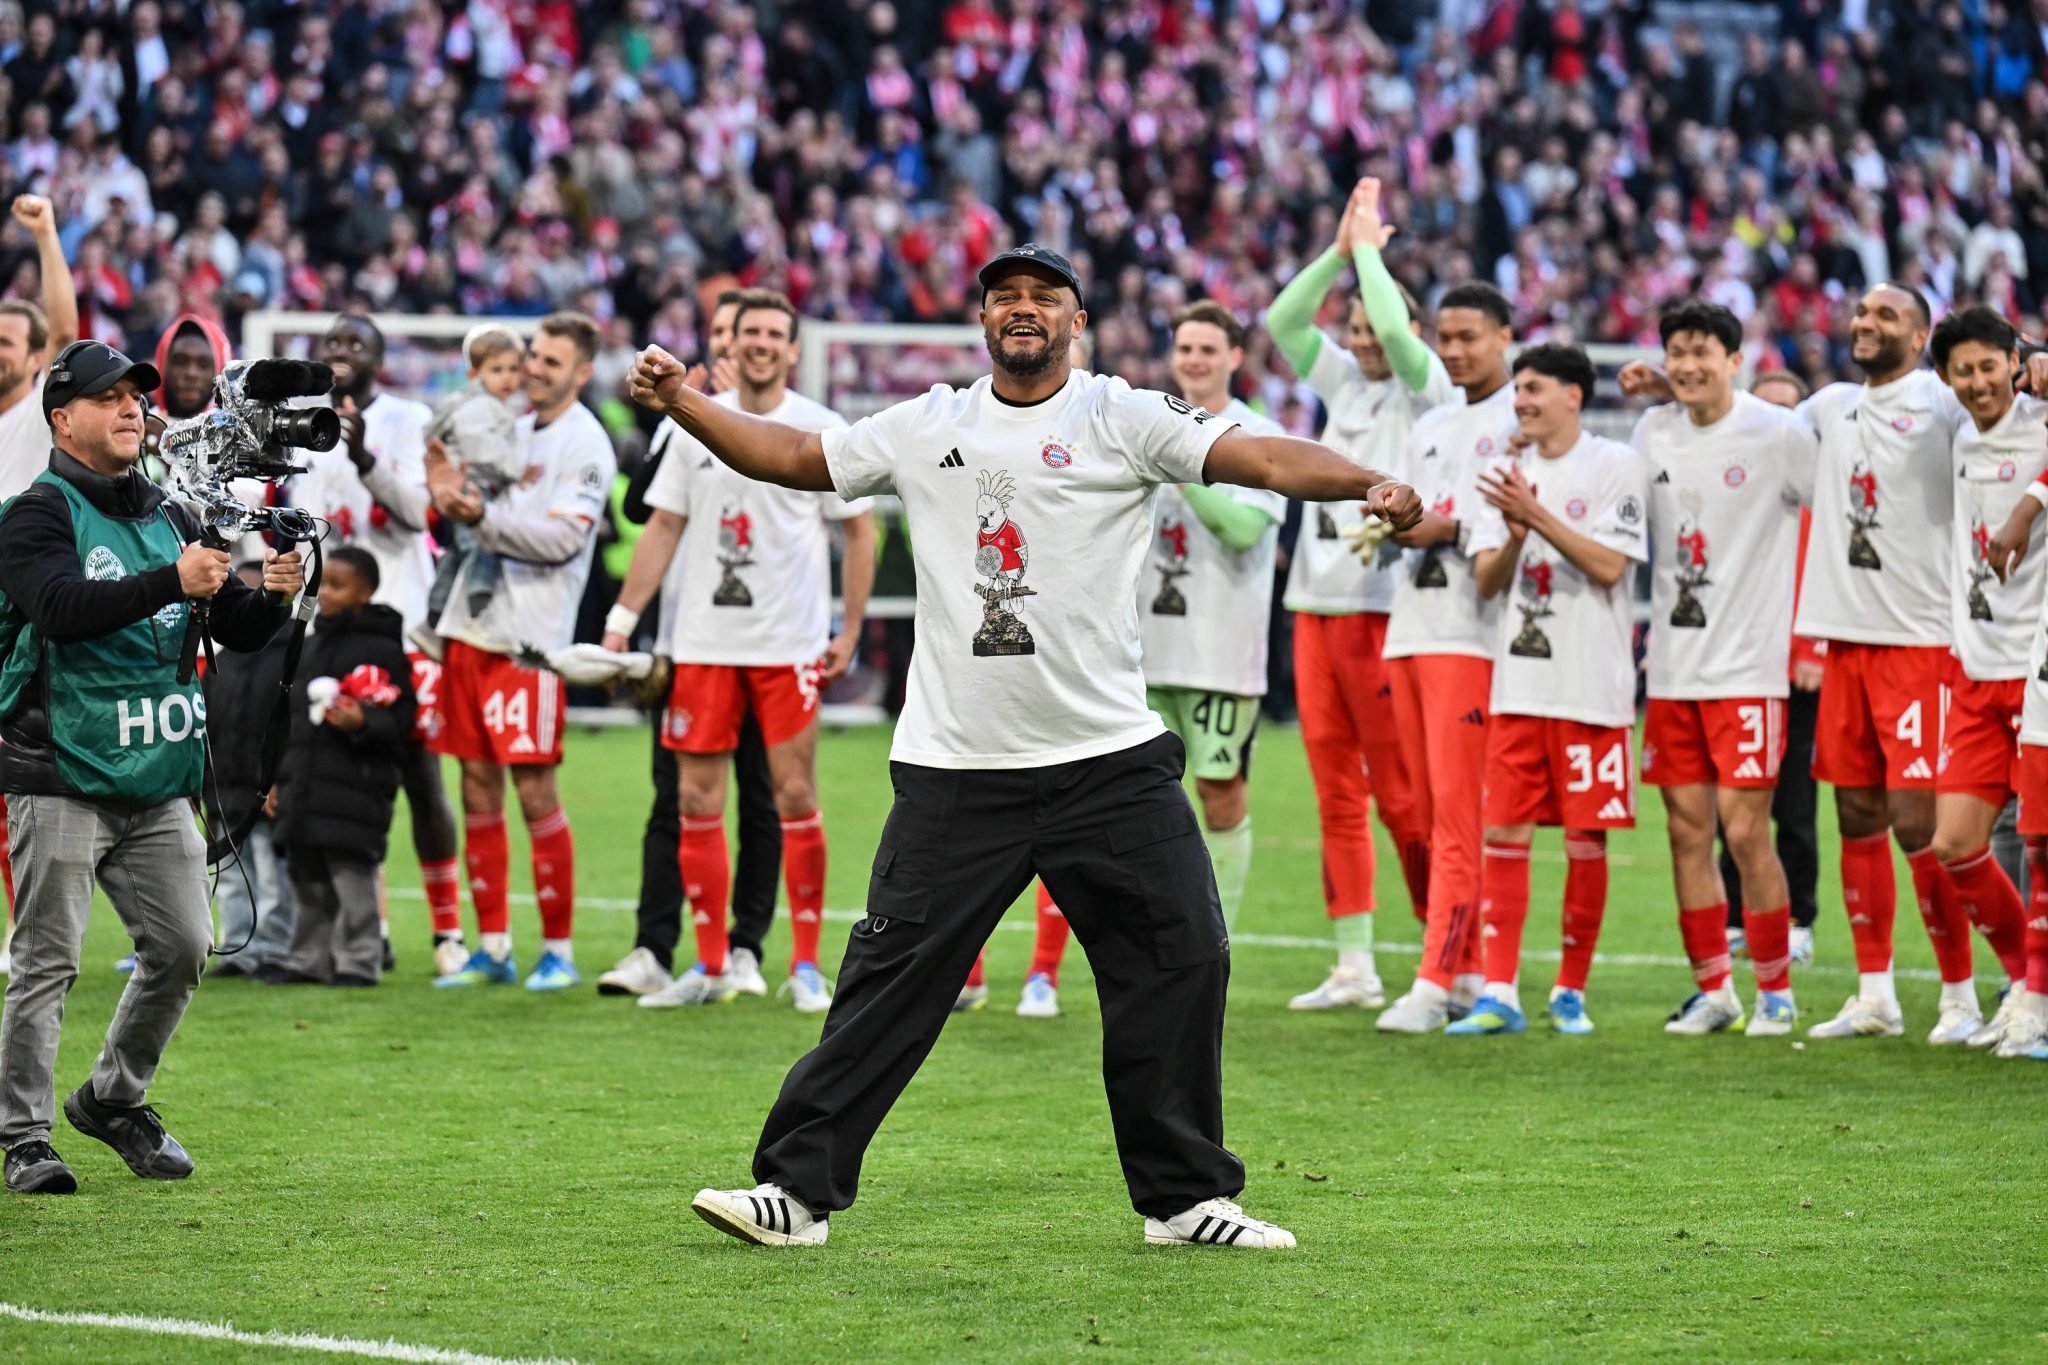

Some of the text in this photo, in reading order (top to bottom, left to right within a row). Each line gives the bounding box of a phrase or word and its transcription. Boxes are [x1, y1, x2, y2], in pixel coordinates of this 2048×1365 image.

[169, 430, 193, 446] ONIN
[89, 556, 96, 568] FC
[117, 692, 206, 747] HOS
[483, 687, 529, 734] 44
[1192, 691, 1238, 736] 40
[1737, 705, 1764, 753] 3
[1897, 700, 1922, 748] 4
[1566, 743, 1625, 792] 34
